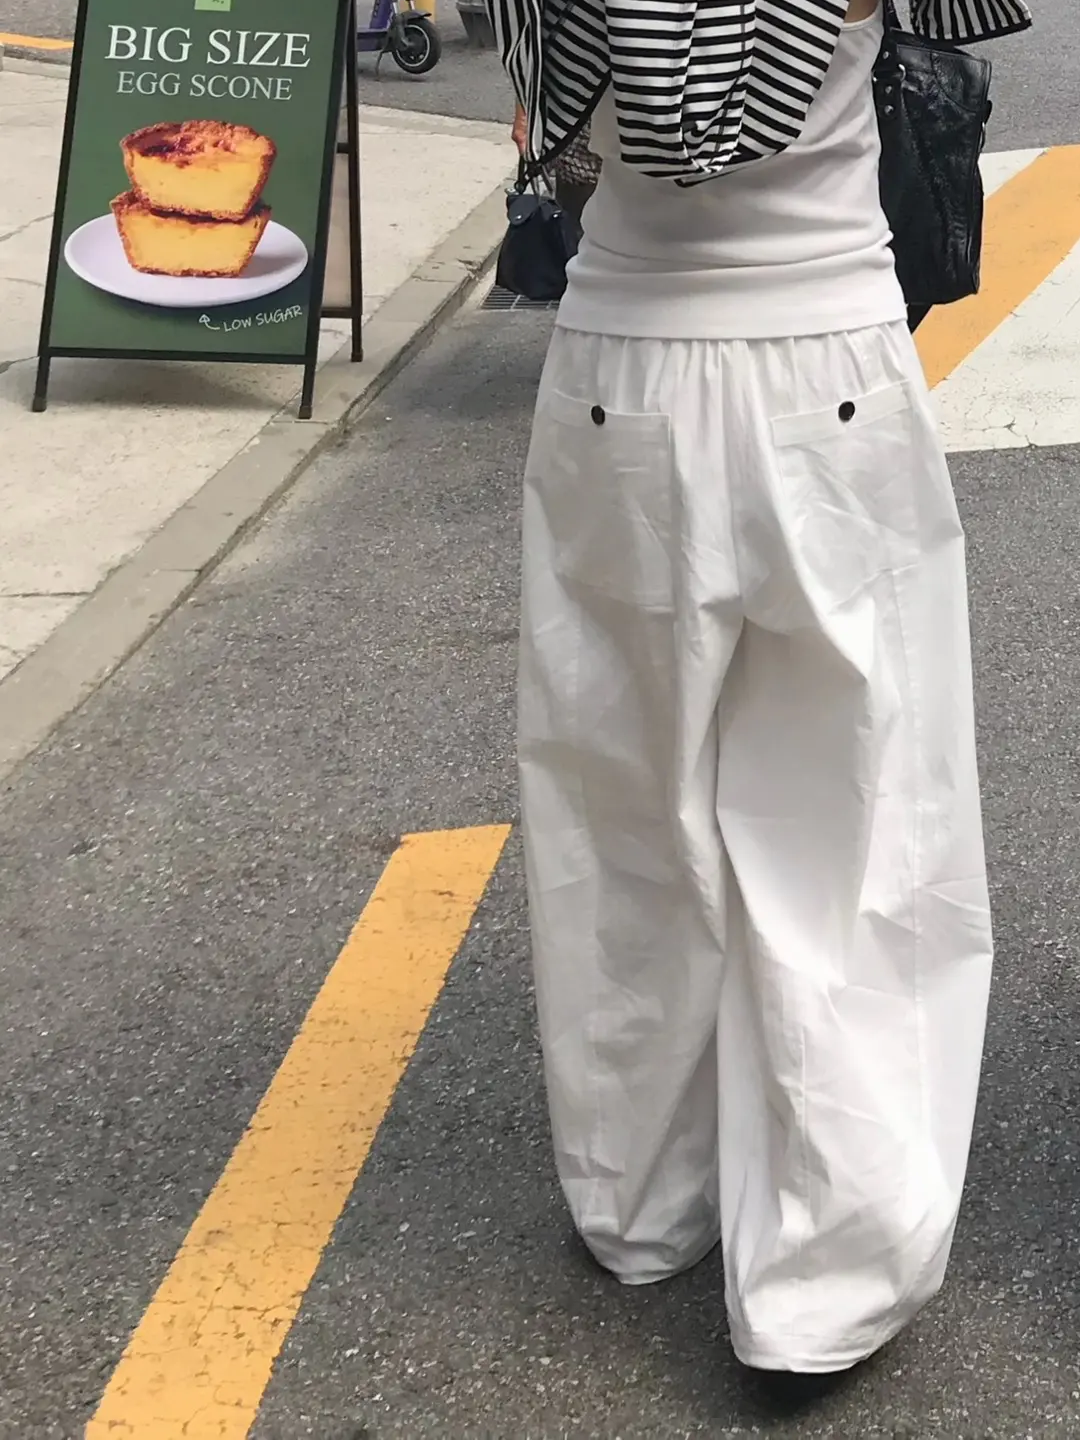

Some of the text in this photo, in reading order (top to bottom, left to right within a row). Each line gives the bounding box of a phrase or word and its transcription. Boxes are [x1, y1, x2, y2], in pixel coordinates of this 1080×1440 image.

[104, 24, 311, 68] BIG SIZE
[116, 71, 293, 100] EGG SCONE
[223, 304, 303, 332] LOW SUGAR
